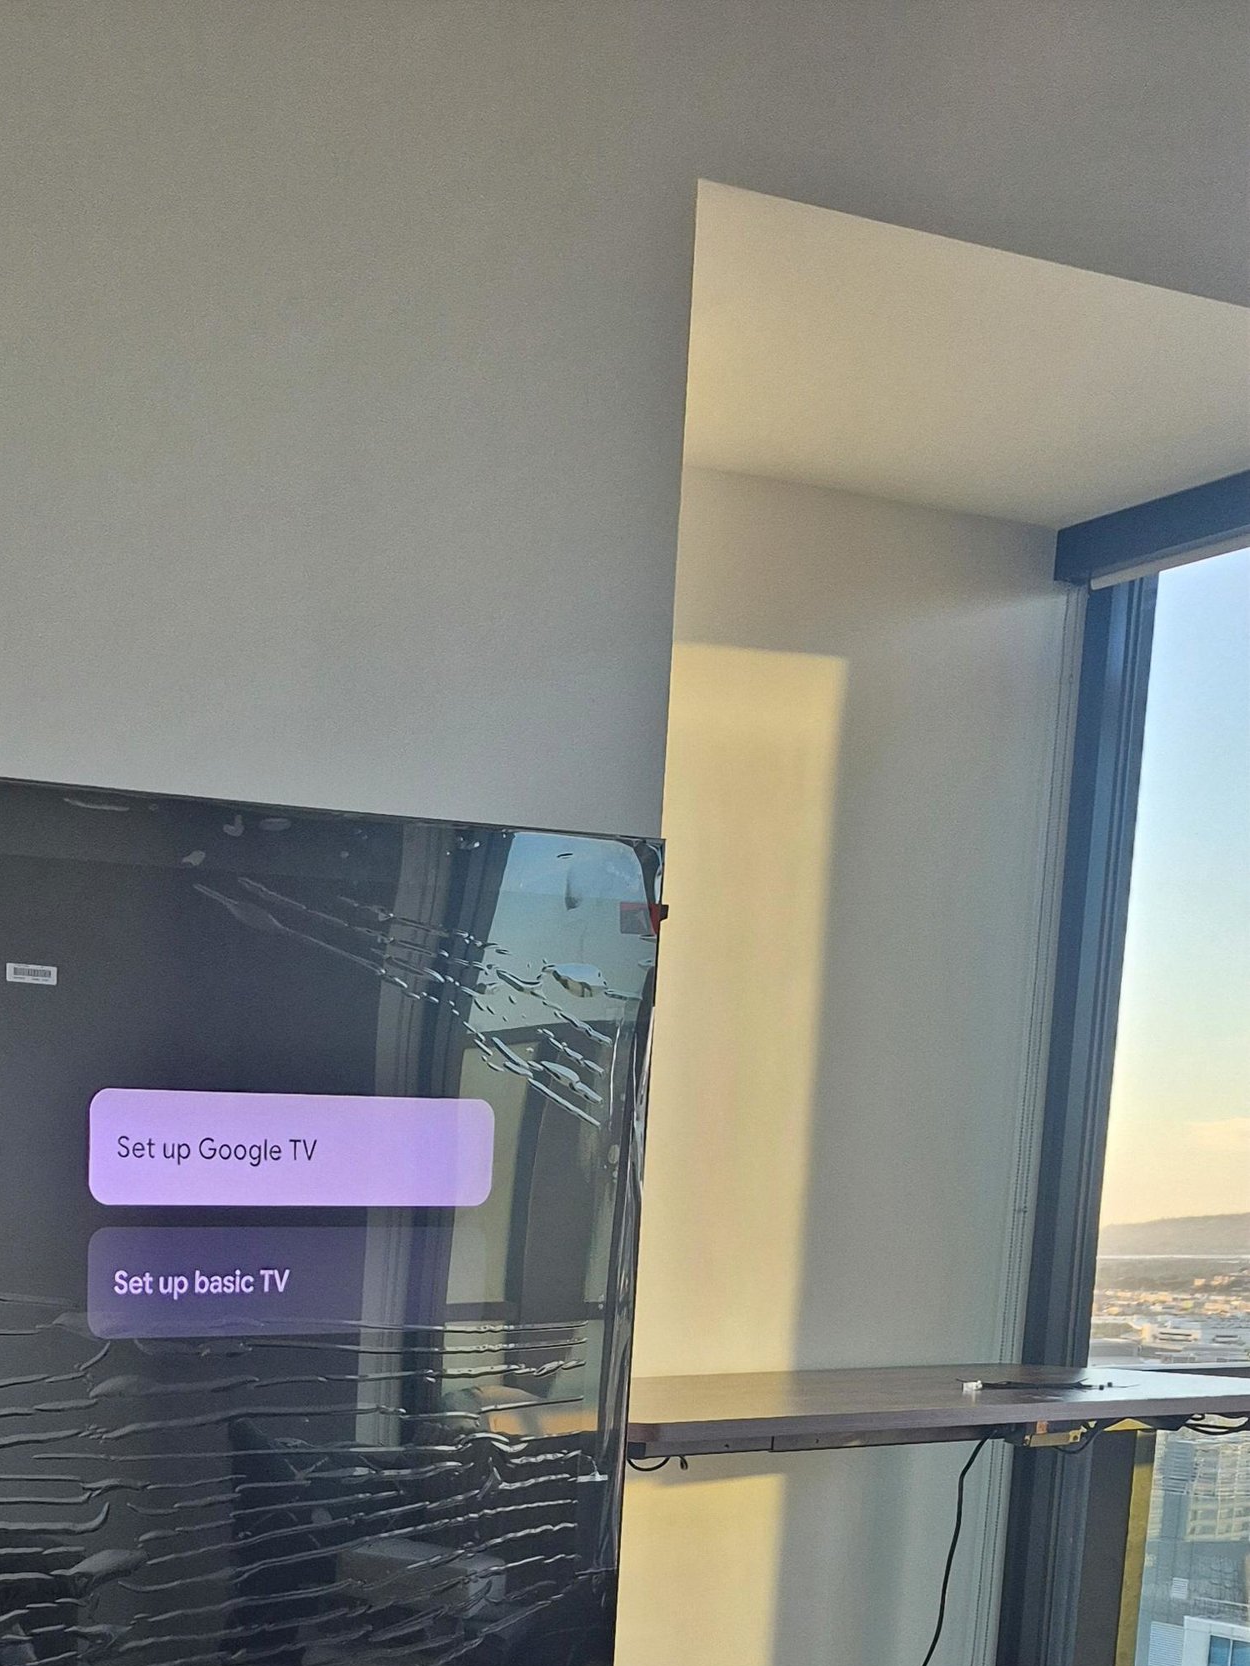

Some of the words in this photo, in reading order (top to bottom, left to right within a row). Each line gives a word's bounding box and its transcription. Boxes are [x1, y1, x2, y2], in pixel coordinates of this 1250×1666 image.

[117, 1135, 156, 1159] Set
[163, 1142, 191, 1165] up
[198, 1137, 282, 1167] Google
[288, 1138, 318, 1161] TV
[113, 1270, 154, 1295] Set
[159, 1275, 189, 1299] up
[194, 1269, 255, 1294] basic
[259, 1269, 290, 1293] TV
